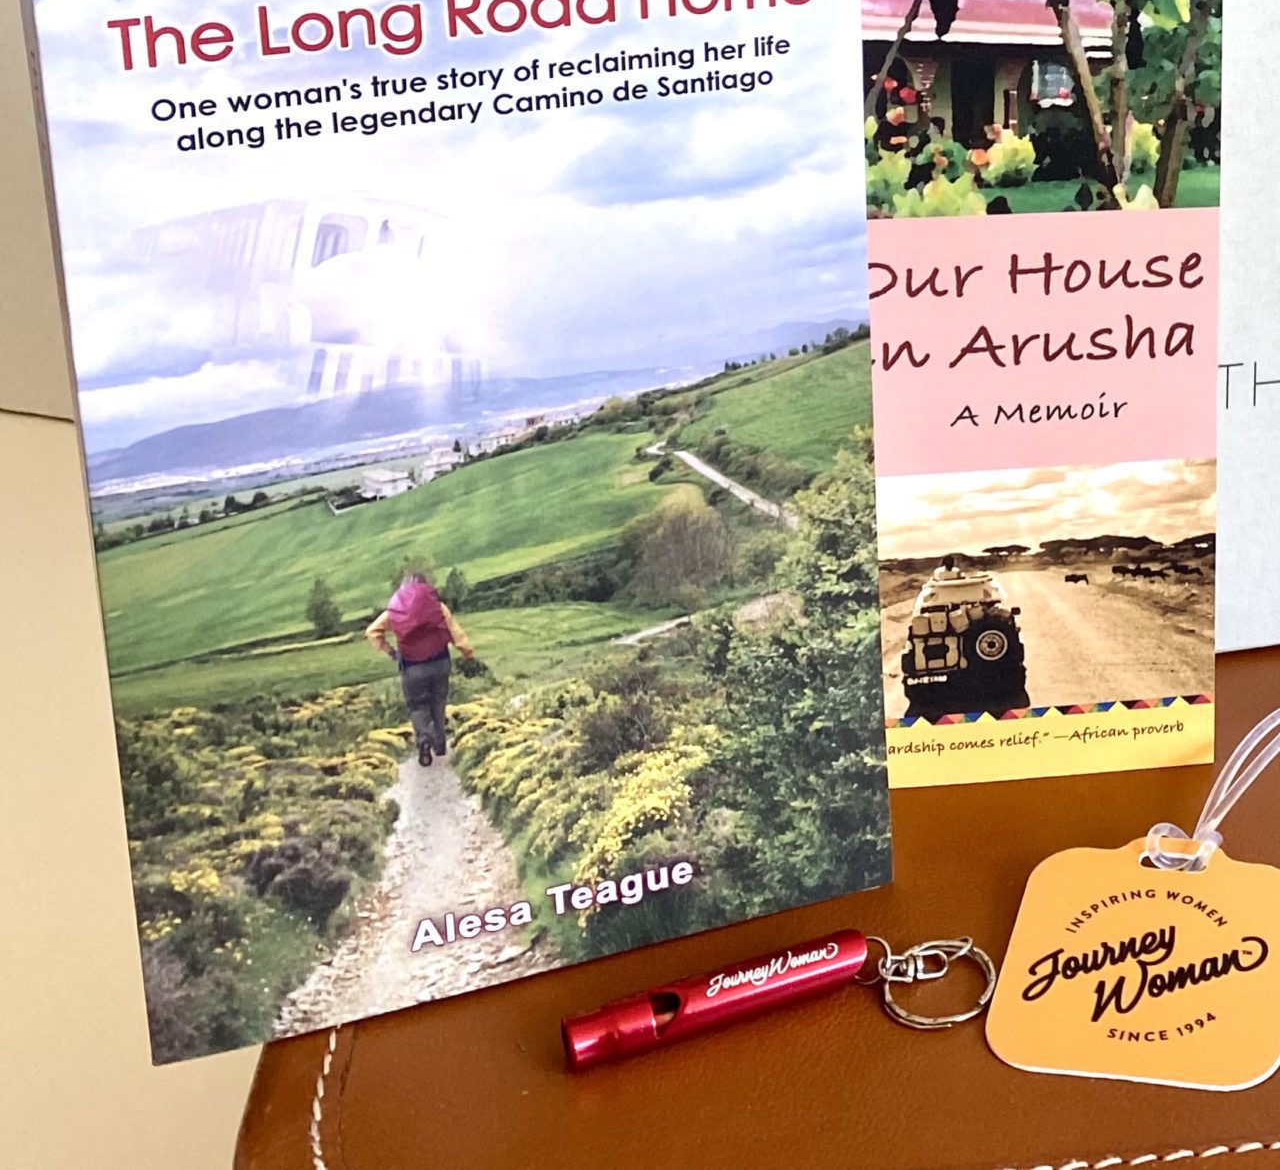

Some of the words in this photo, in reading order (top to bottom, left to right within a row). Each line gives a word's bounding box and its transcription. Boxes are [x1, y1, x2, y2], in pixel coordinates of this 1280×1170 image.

[107, 15, 234, 71] The
[259, 0, 424, 56] Long
[151, 98, 217, 122] One
[227, 78, 363, 113] woman's
[372, 76, 428, 98] true
[437, 67, 504, 90] story
[513, 59, 540, 82] of
[548, 46, 695, 79] reclaiming
[704, 41, 746, 63] her
[754, 35, 791, 57] life
[176, 123, 266, 151] along
[275, 115, 322, 140] the
[332, 100, 483, 135] legendary
[493, 85, 604, 115] Camino
[613, 80, 648, 101] de
[657, 69, 773, 97] Santiago
[1008, 251, 1204, 295] House
[872, 341, 930, 371] n
[949, 314, 1195, 369] Arusha
[950, 405, 979, 427] A
[994, 392, 1128, 425] Memoir
[888, 739, 945, 757] ardship
[949, 738, 995, 751] comes
[1132, 720, 1184, 740] proverb
[410, 899, 532, 953] Alesa
[546, 861, 695, 916] Teague
[1065, 888, 1157, 934] INSPIRING
[1166, 890, 1229, 928] WOMEN
[1021, 925, 1176, 1001] Journey
[1107, 1027, 1169, 1042] SINCE
[1177, 1012, 1217, 1037] 1994
